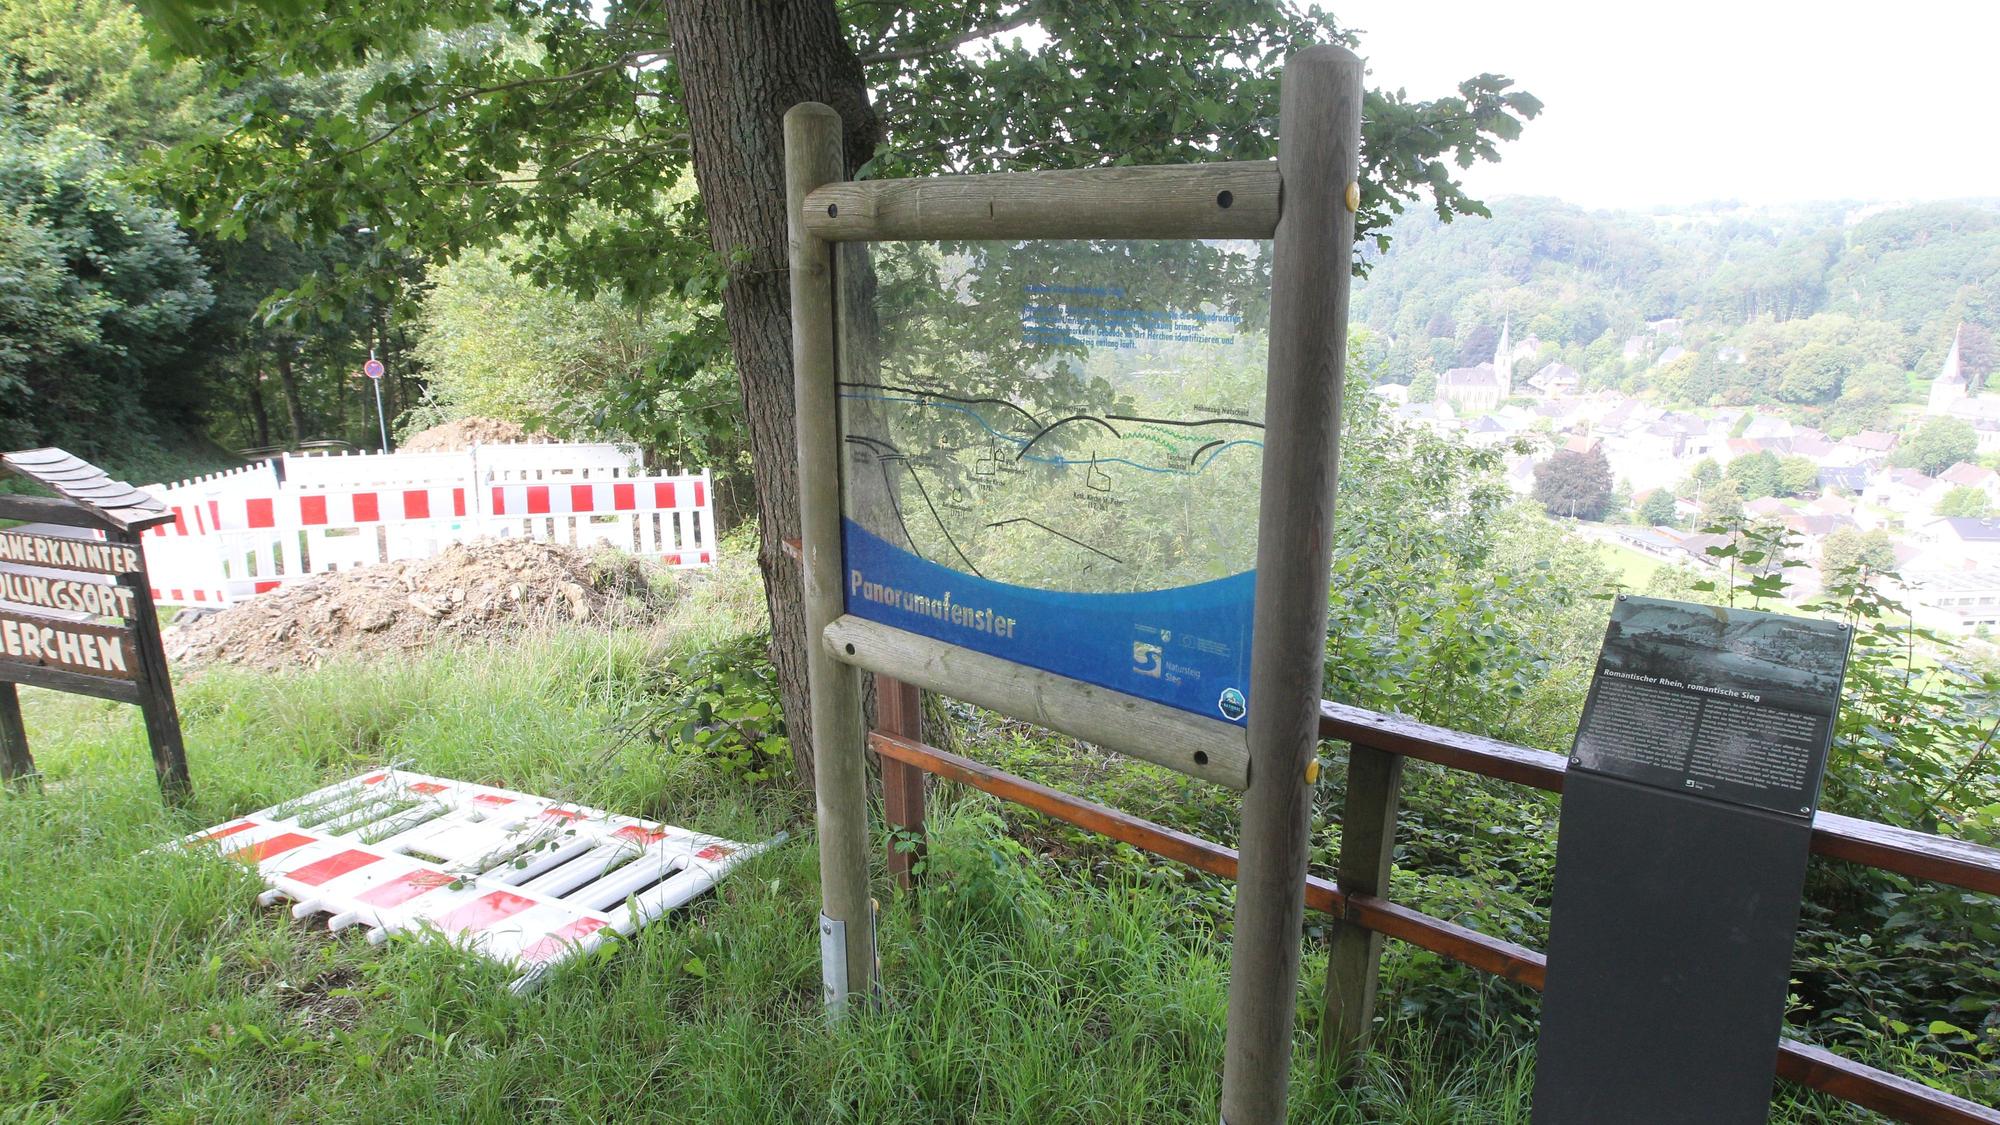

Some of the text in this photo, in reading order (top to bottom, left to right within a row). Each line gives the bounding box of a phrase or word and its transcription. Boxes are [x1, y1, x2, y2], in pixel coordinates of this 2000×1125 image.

[851, 569, 1017, 639] Panoramafenster
[0, 619, 128, 673] ERCHEN
[1603, 668, 1761, 703] Romantischer Rhein, romantische Sieg
